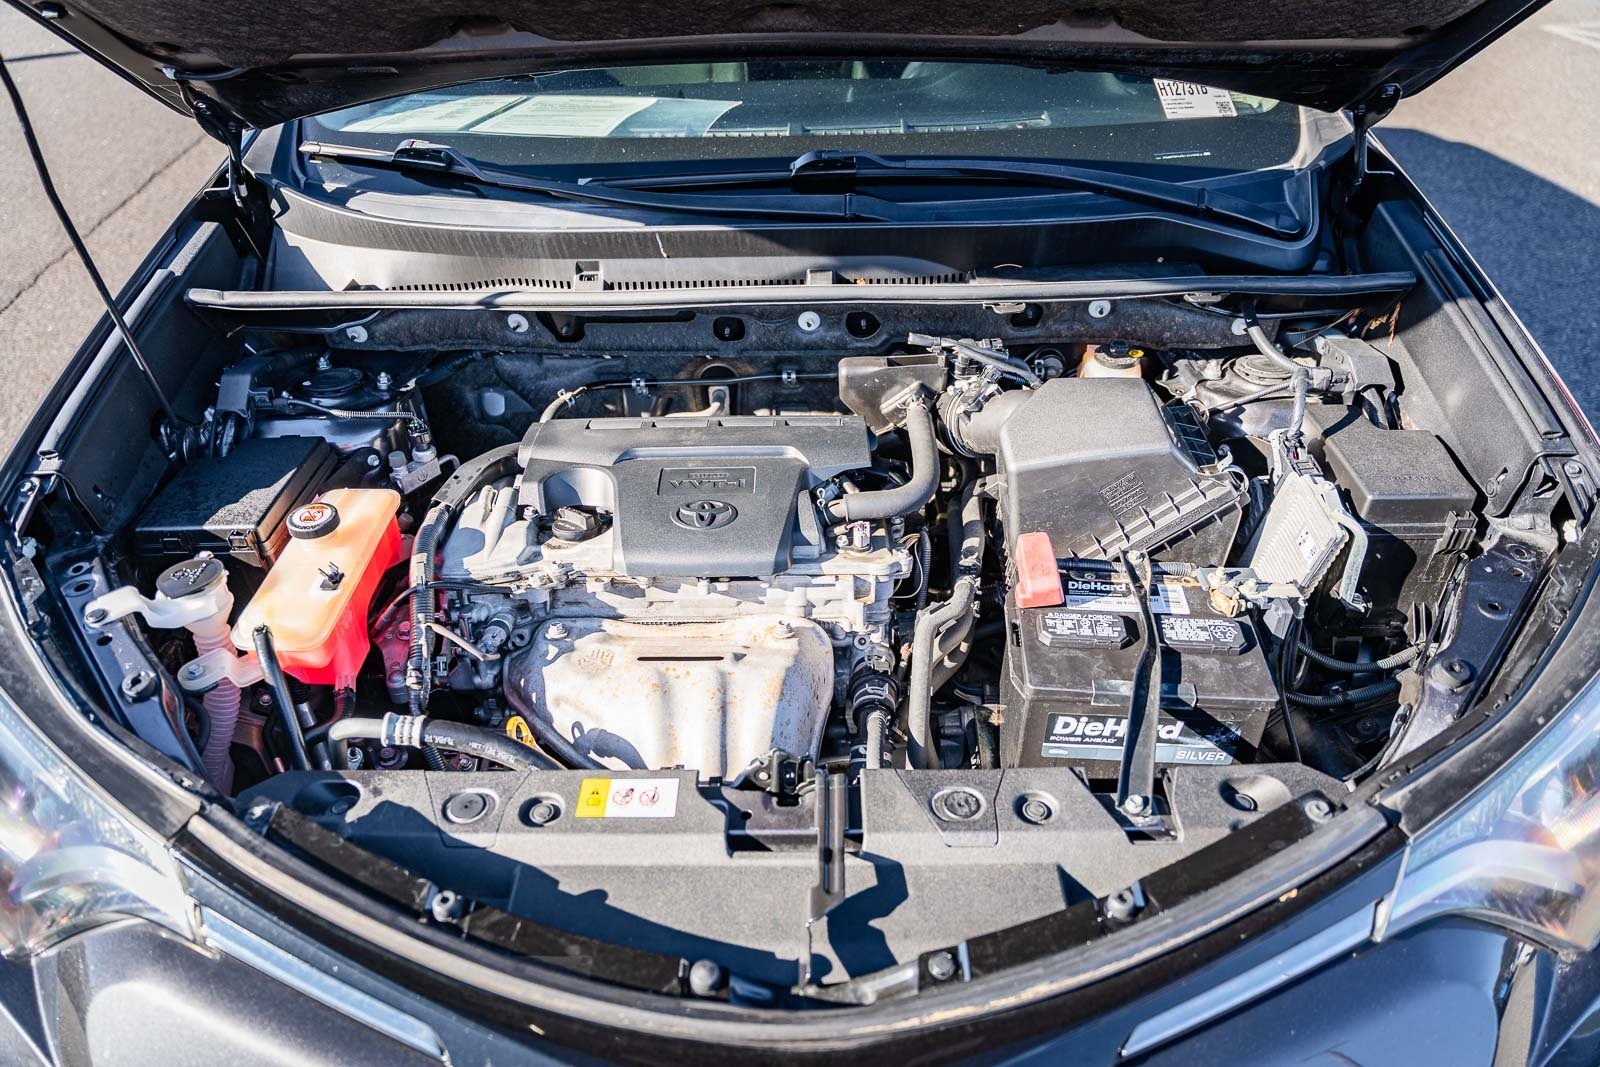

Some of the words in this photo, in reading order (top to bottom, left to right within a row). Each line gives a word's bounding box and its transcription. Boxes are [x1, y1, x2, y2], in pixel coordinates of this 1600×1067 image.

[1067, 580, 1127, 592] DieHard
[1053, 716, 1185, 739] DieHd
[1049, 735, 1082, 743] POWER
[1175, 750, 1226, 761] SILVER
